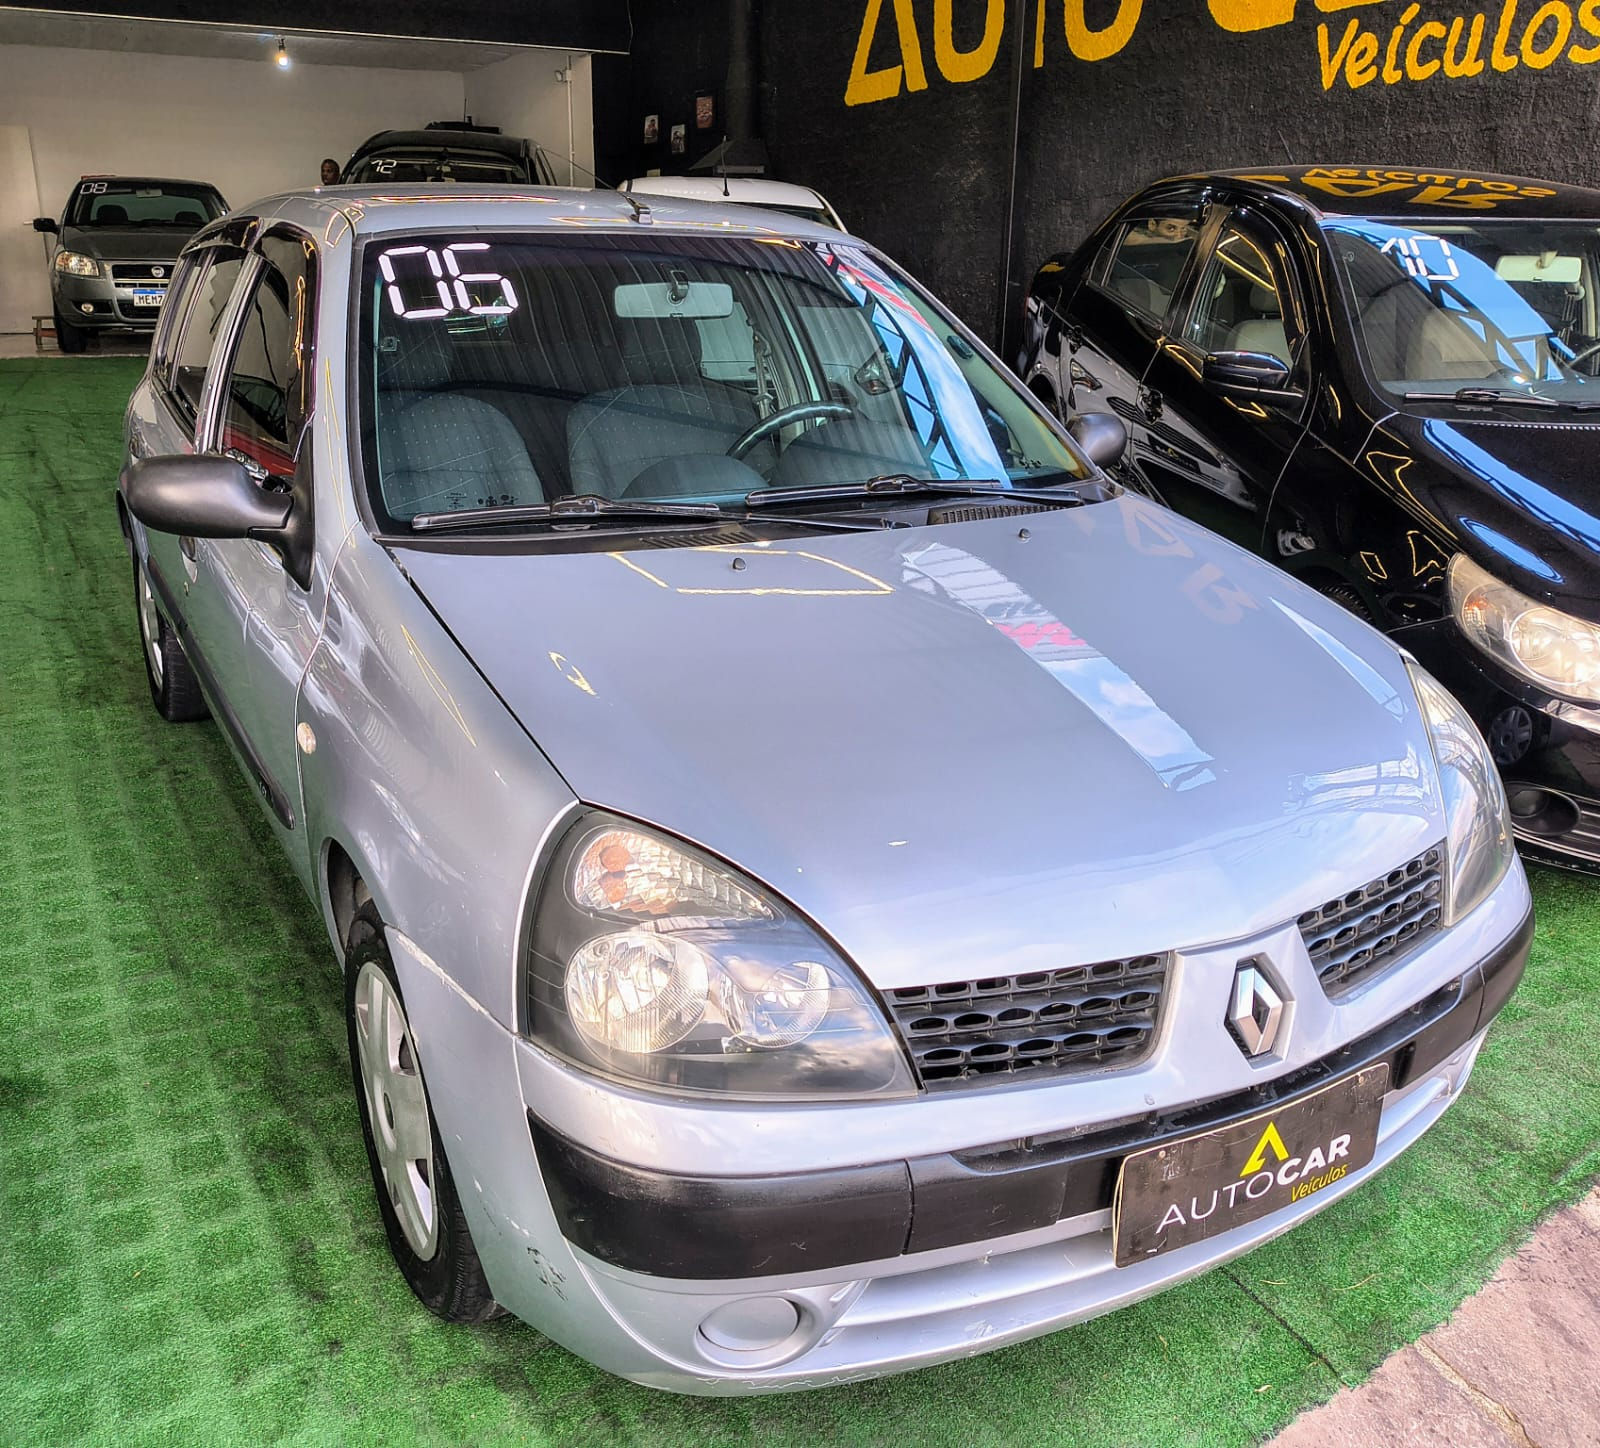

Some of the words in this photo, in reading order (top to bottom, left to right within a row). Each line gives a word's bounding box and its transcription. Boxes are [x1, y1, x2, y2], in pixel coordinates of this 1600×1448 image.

[371, 159, 397, 174] 12
[80, 182, 108, 194] 08
[1380, 235, 1461, 281] 10
[378, 242, 519, 319] 06
[1155, 1133, 1352, 1235] AUTOCAR
[1291, 1163, 1347, 1202] Veículos
